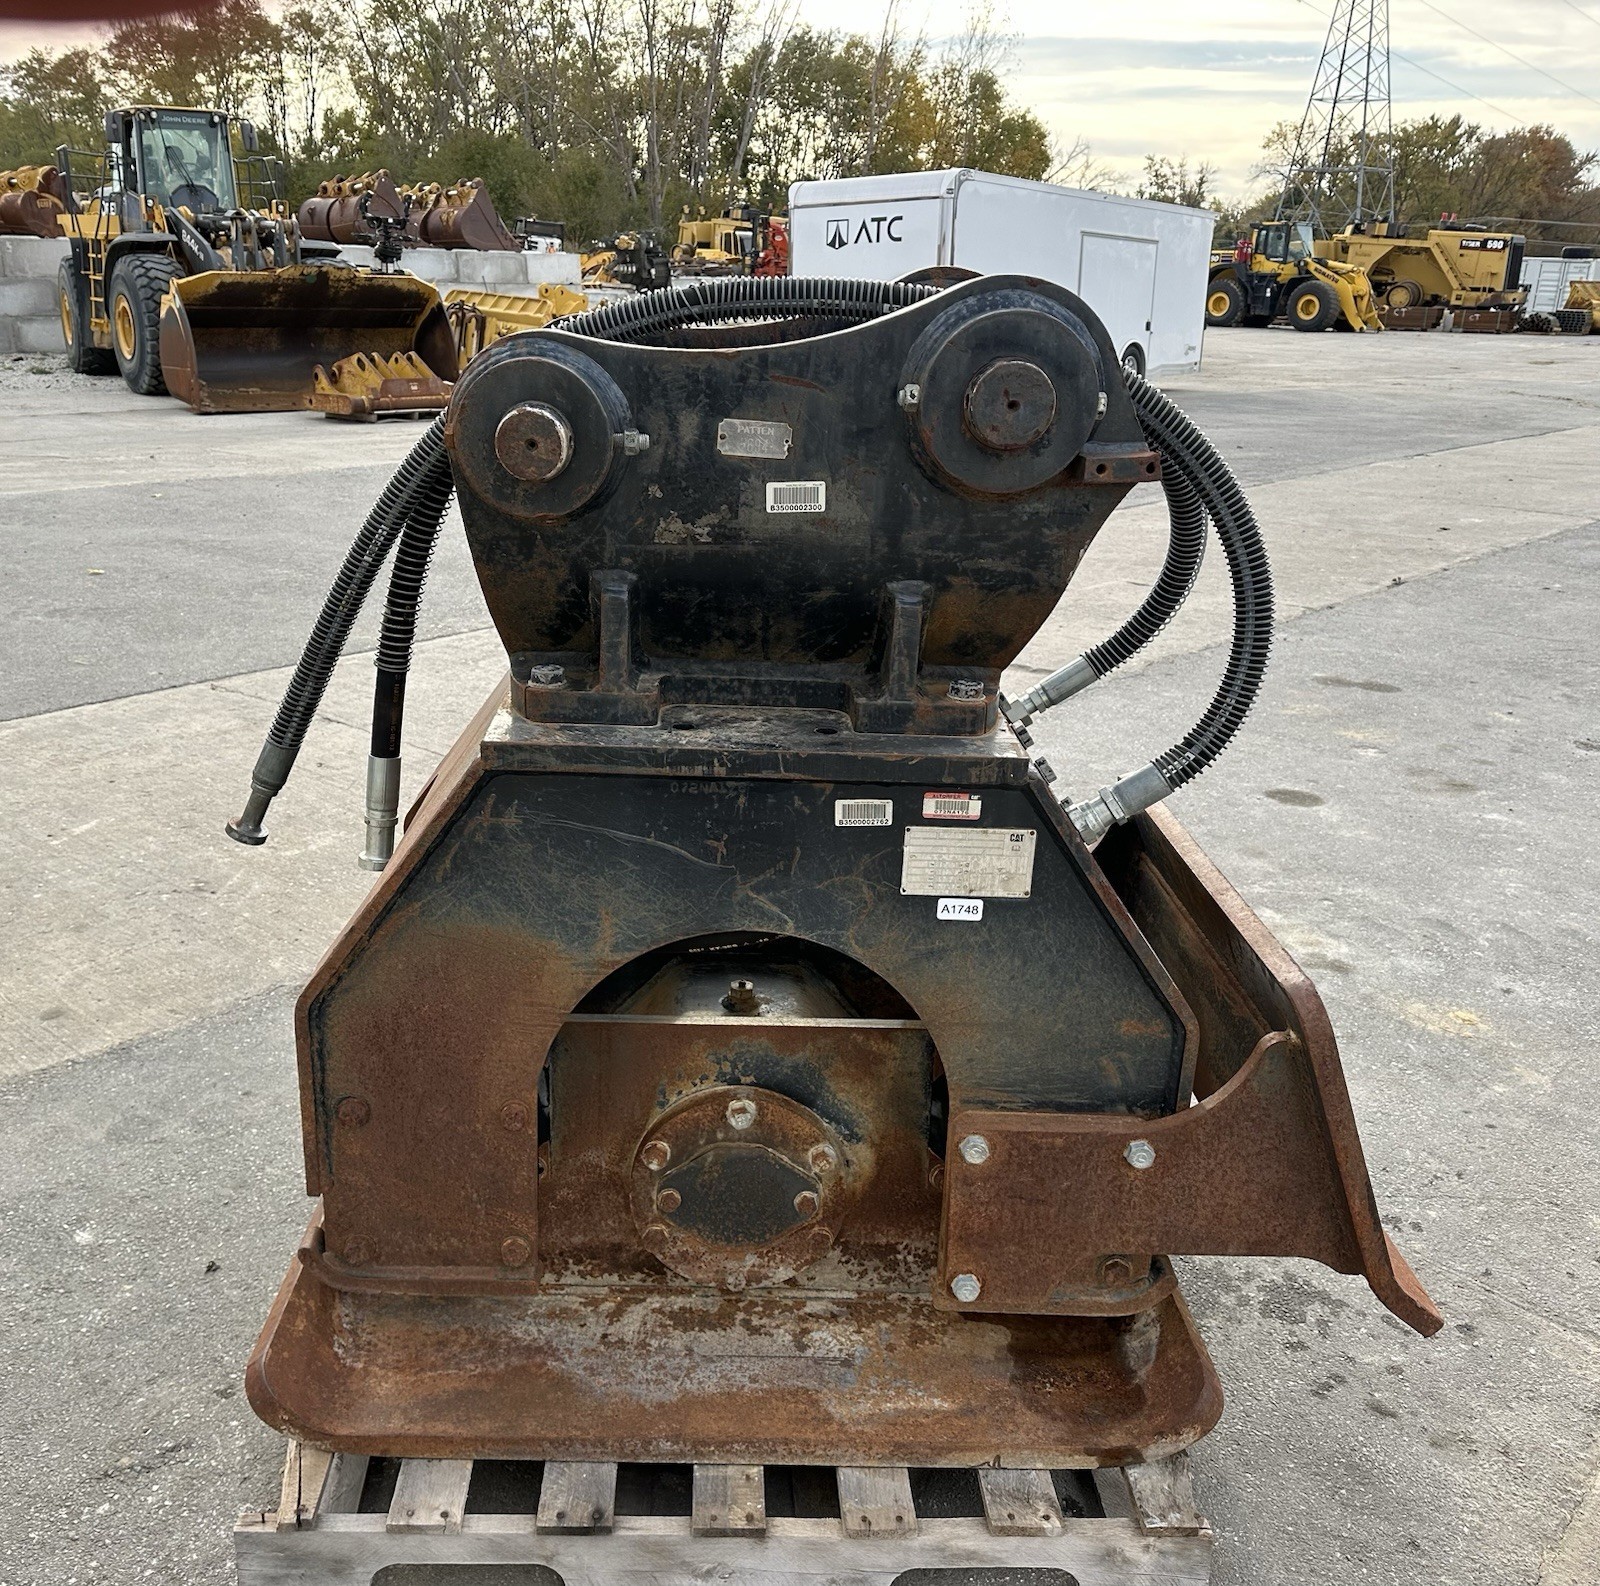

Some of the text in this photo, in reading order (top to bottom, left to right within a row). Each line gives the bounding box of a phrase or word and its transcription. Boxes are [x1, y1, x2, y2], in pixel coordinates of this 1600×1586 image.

[182, 116, 207, 124] DEERE
[853, 215, 904, 244] ATC
[1314, 266, 1340, 284] KOMATSU
[770, 504, 823, 512] B3500002300
[1009, 833, 1025, 842] CAT
[940, 904, 980, 915] A1748
